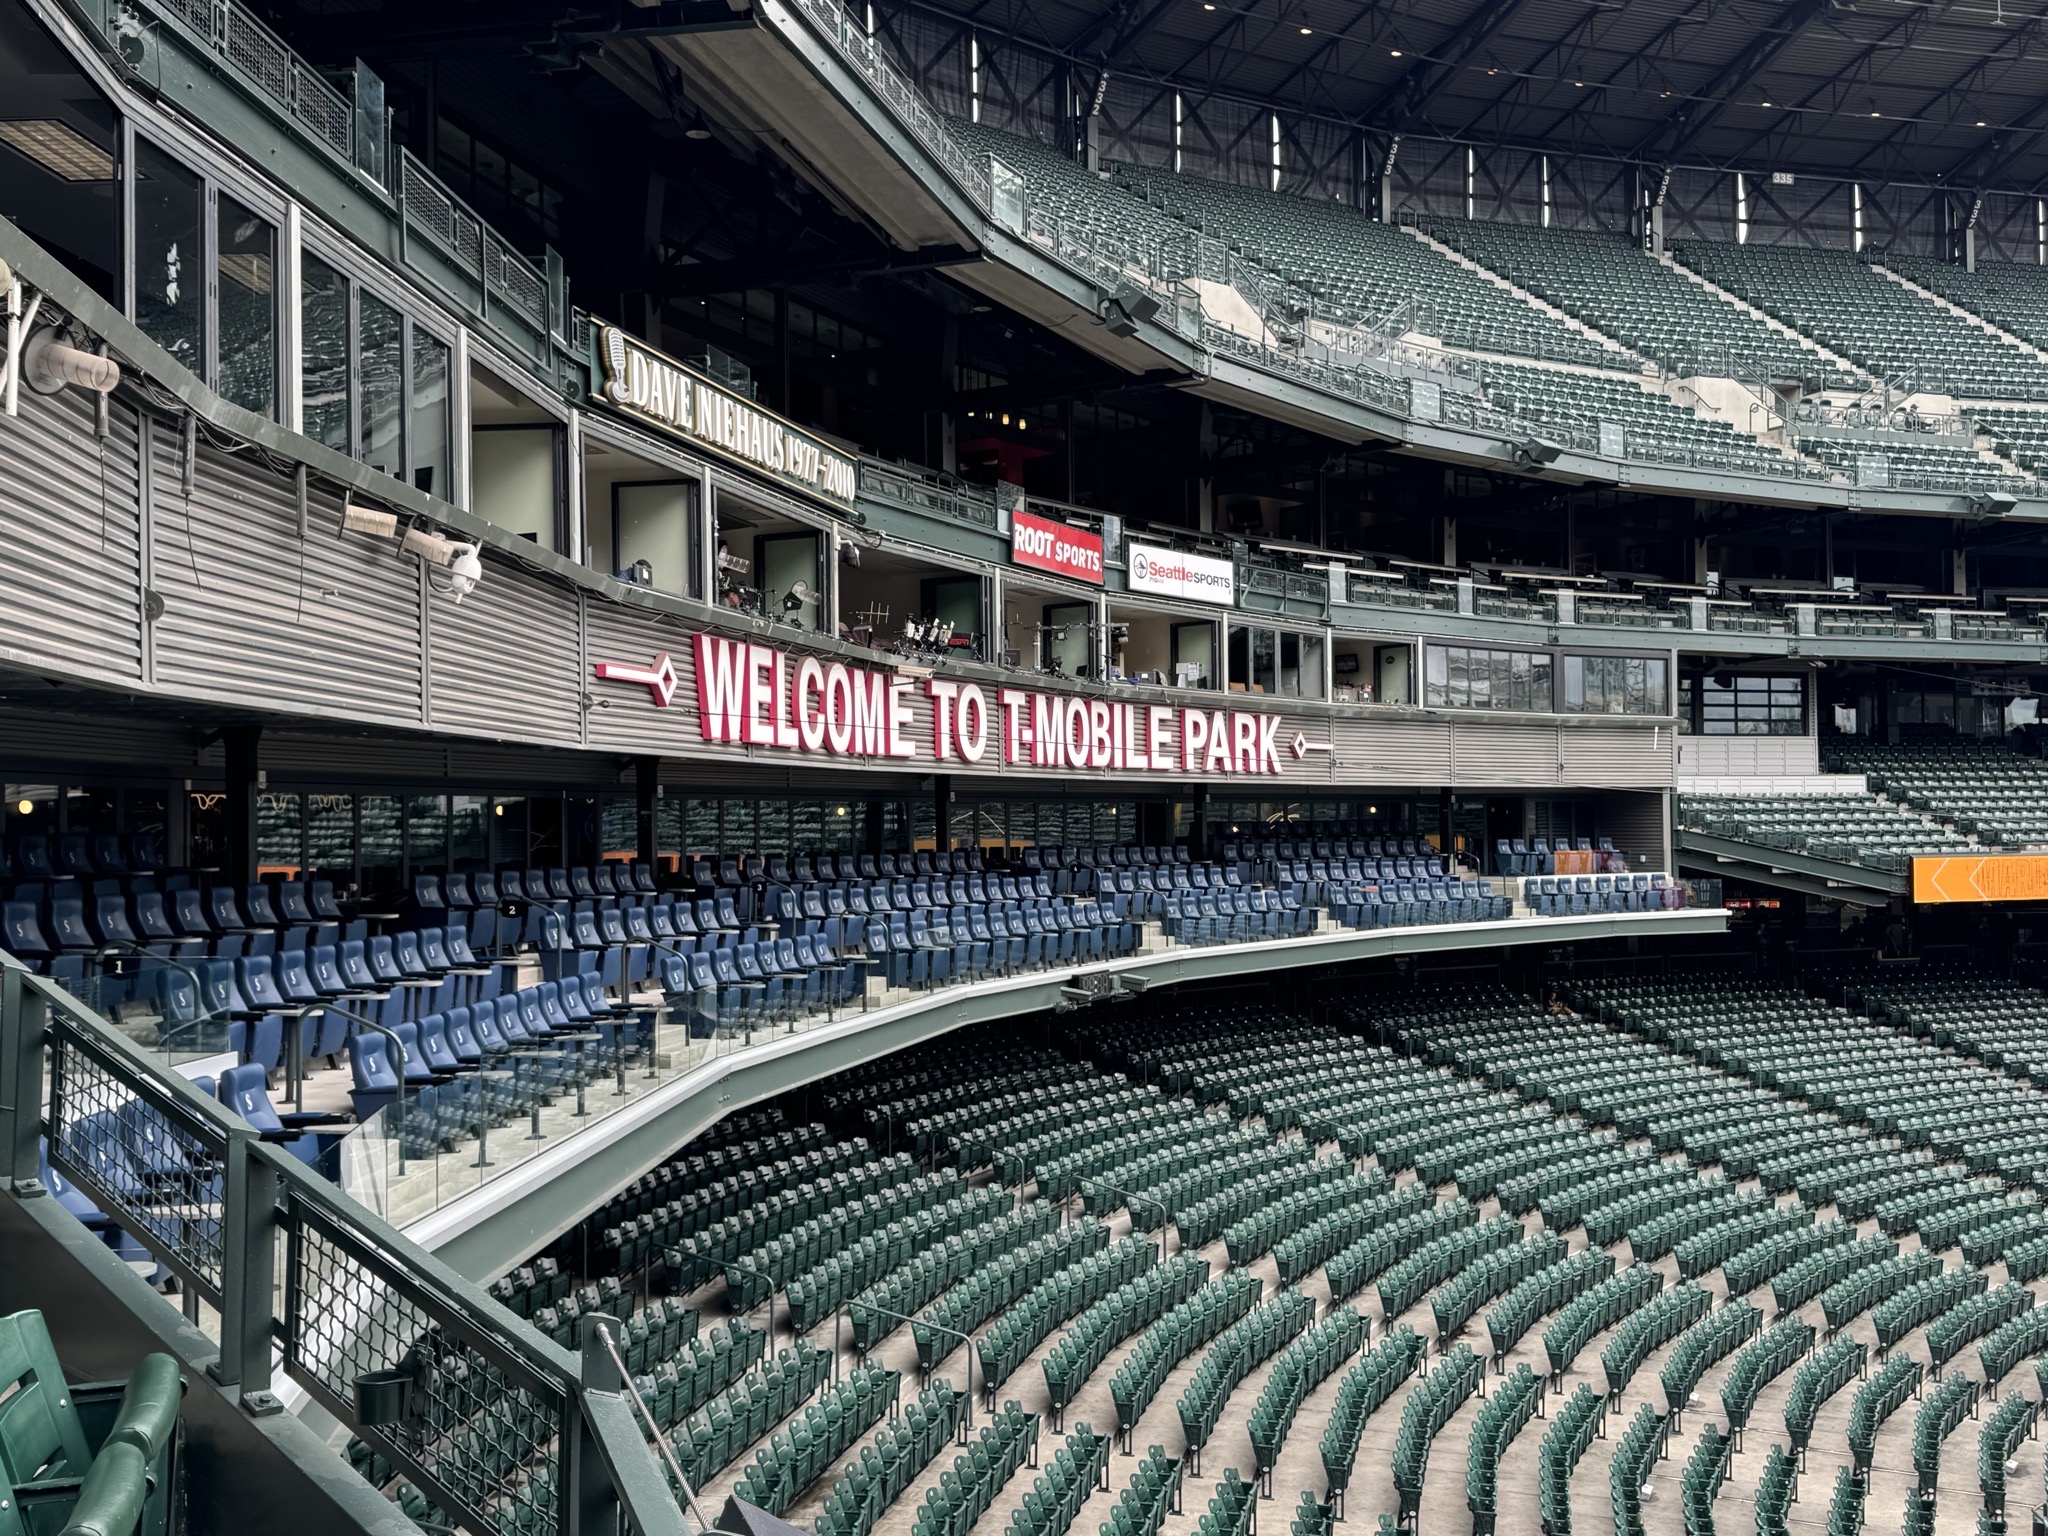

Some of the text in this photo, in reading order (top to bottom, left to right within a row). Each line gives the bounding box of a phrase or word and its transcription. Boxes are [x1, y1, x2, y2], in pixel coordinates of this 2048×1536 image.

[1092, 80, 1107, 116] 332
[1384, 143, 1398, 175] 333
[1656, 175, 1670, 205] 334
[1774, 172, 1792, 184] 335
[1968, 199, 1982, 228] 337
[626, 348, 692, 429] DAVE
[694, 383, 785, 472] NIEHAUS
[1014, 523, 1100, 572] ROOT SPORTS
[949, 637, 970, 646] ESPN
[692, 633, 1283, 774] WELCOME TO T-MOBILE PARK
[508, 905, 516, 915] 2
[114, 960, 123, 974] 1
